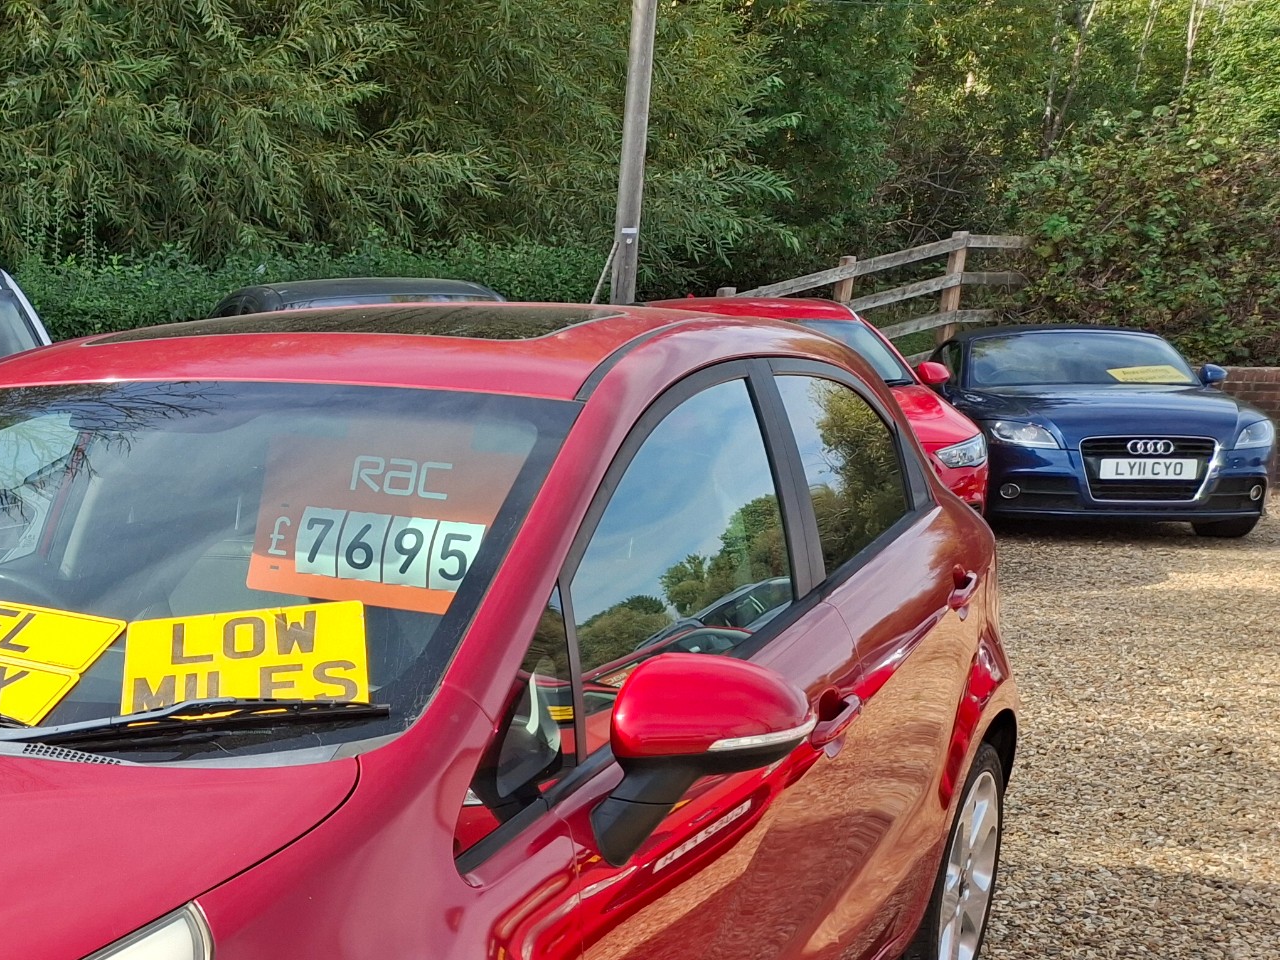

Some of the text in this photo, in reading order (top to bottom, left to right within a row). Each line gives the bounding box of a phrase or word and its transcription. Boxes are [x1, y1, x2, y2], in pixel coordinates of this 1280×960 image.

[1115, 461, 1184, 476] LY11 CYO
[171, 610, 317, 666] LOW
[131, 659, 358, 714] MILES
